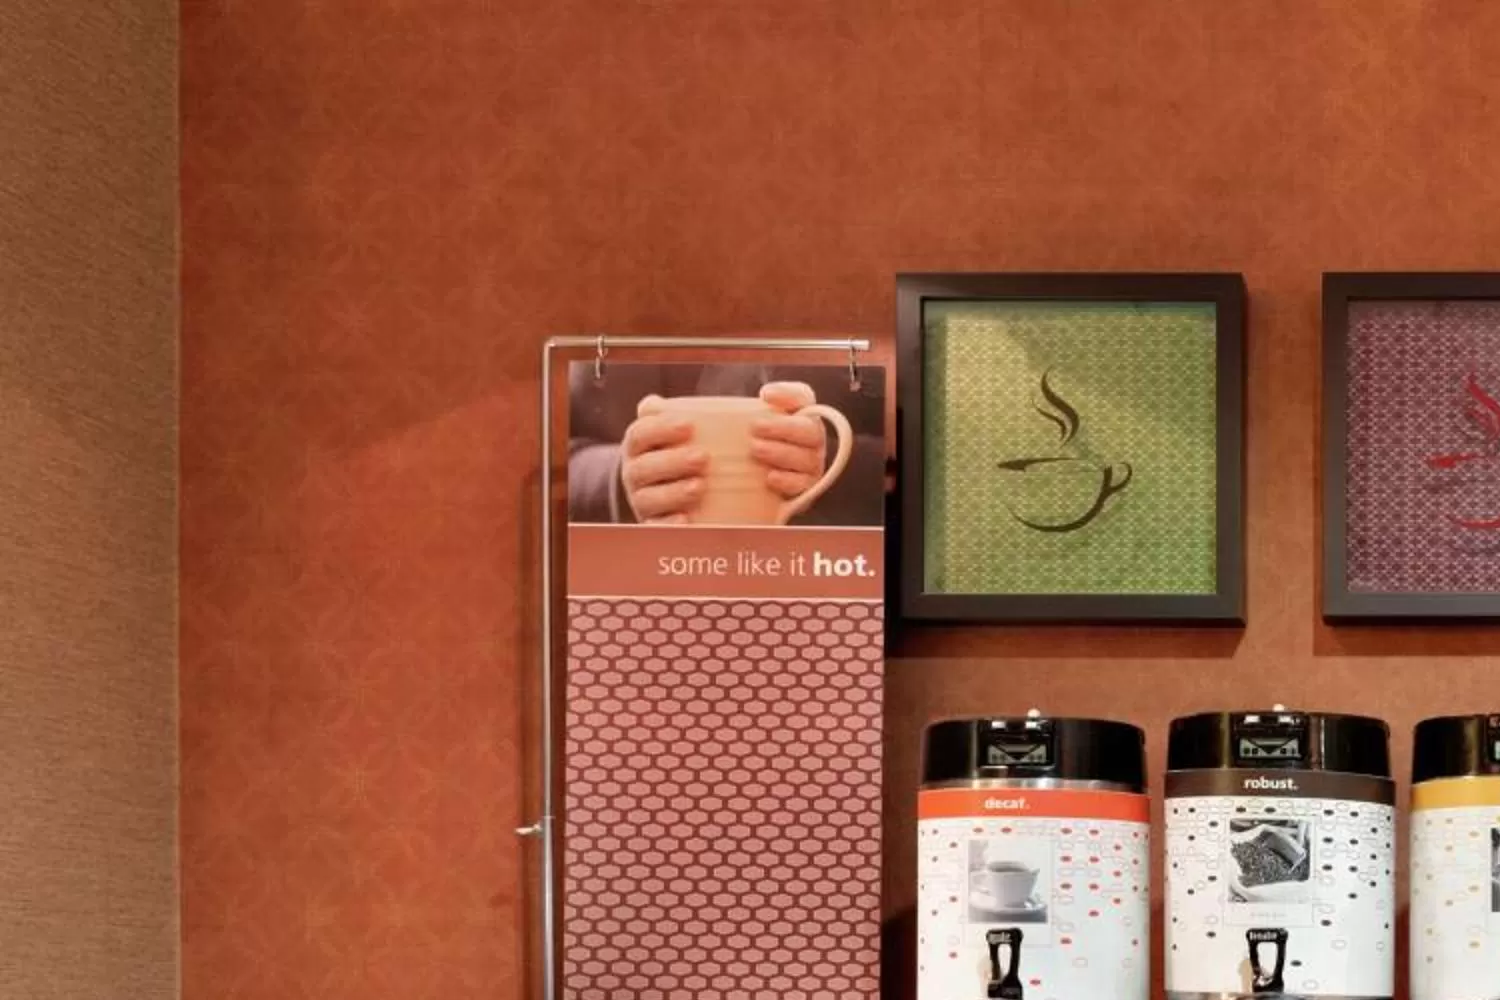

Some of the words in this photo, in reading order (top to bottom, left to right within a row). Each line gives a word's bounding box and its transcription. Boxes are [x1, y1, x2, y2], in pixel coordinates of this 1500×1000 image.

[657, 555, 728, 577] some
[737, 551, 782, 577] like
[790, 551, 807, 577] it
[812, 550, 877, 577] hot.
[1243, 775, 1300, 790] robust.
[984, 796, 1031, 810] decaf.
